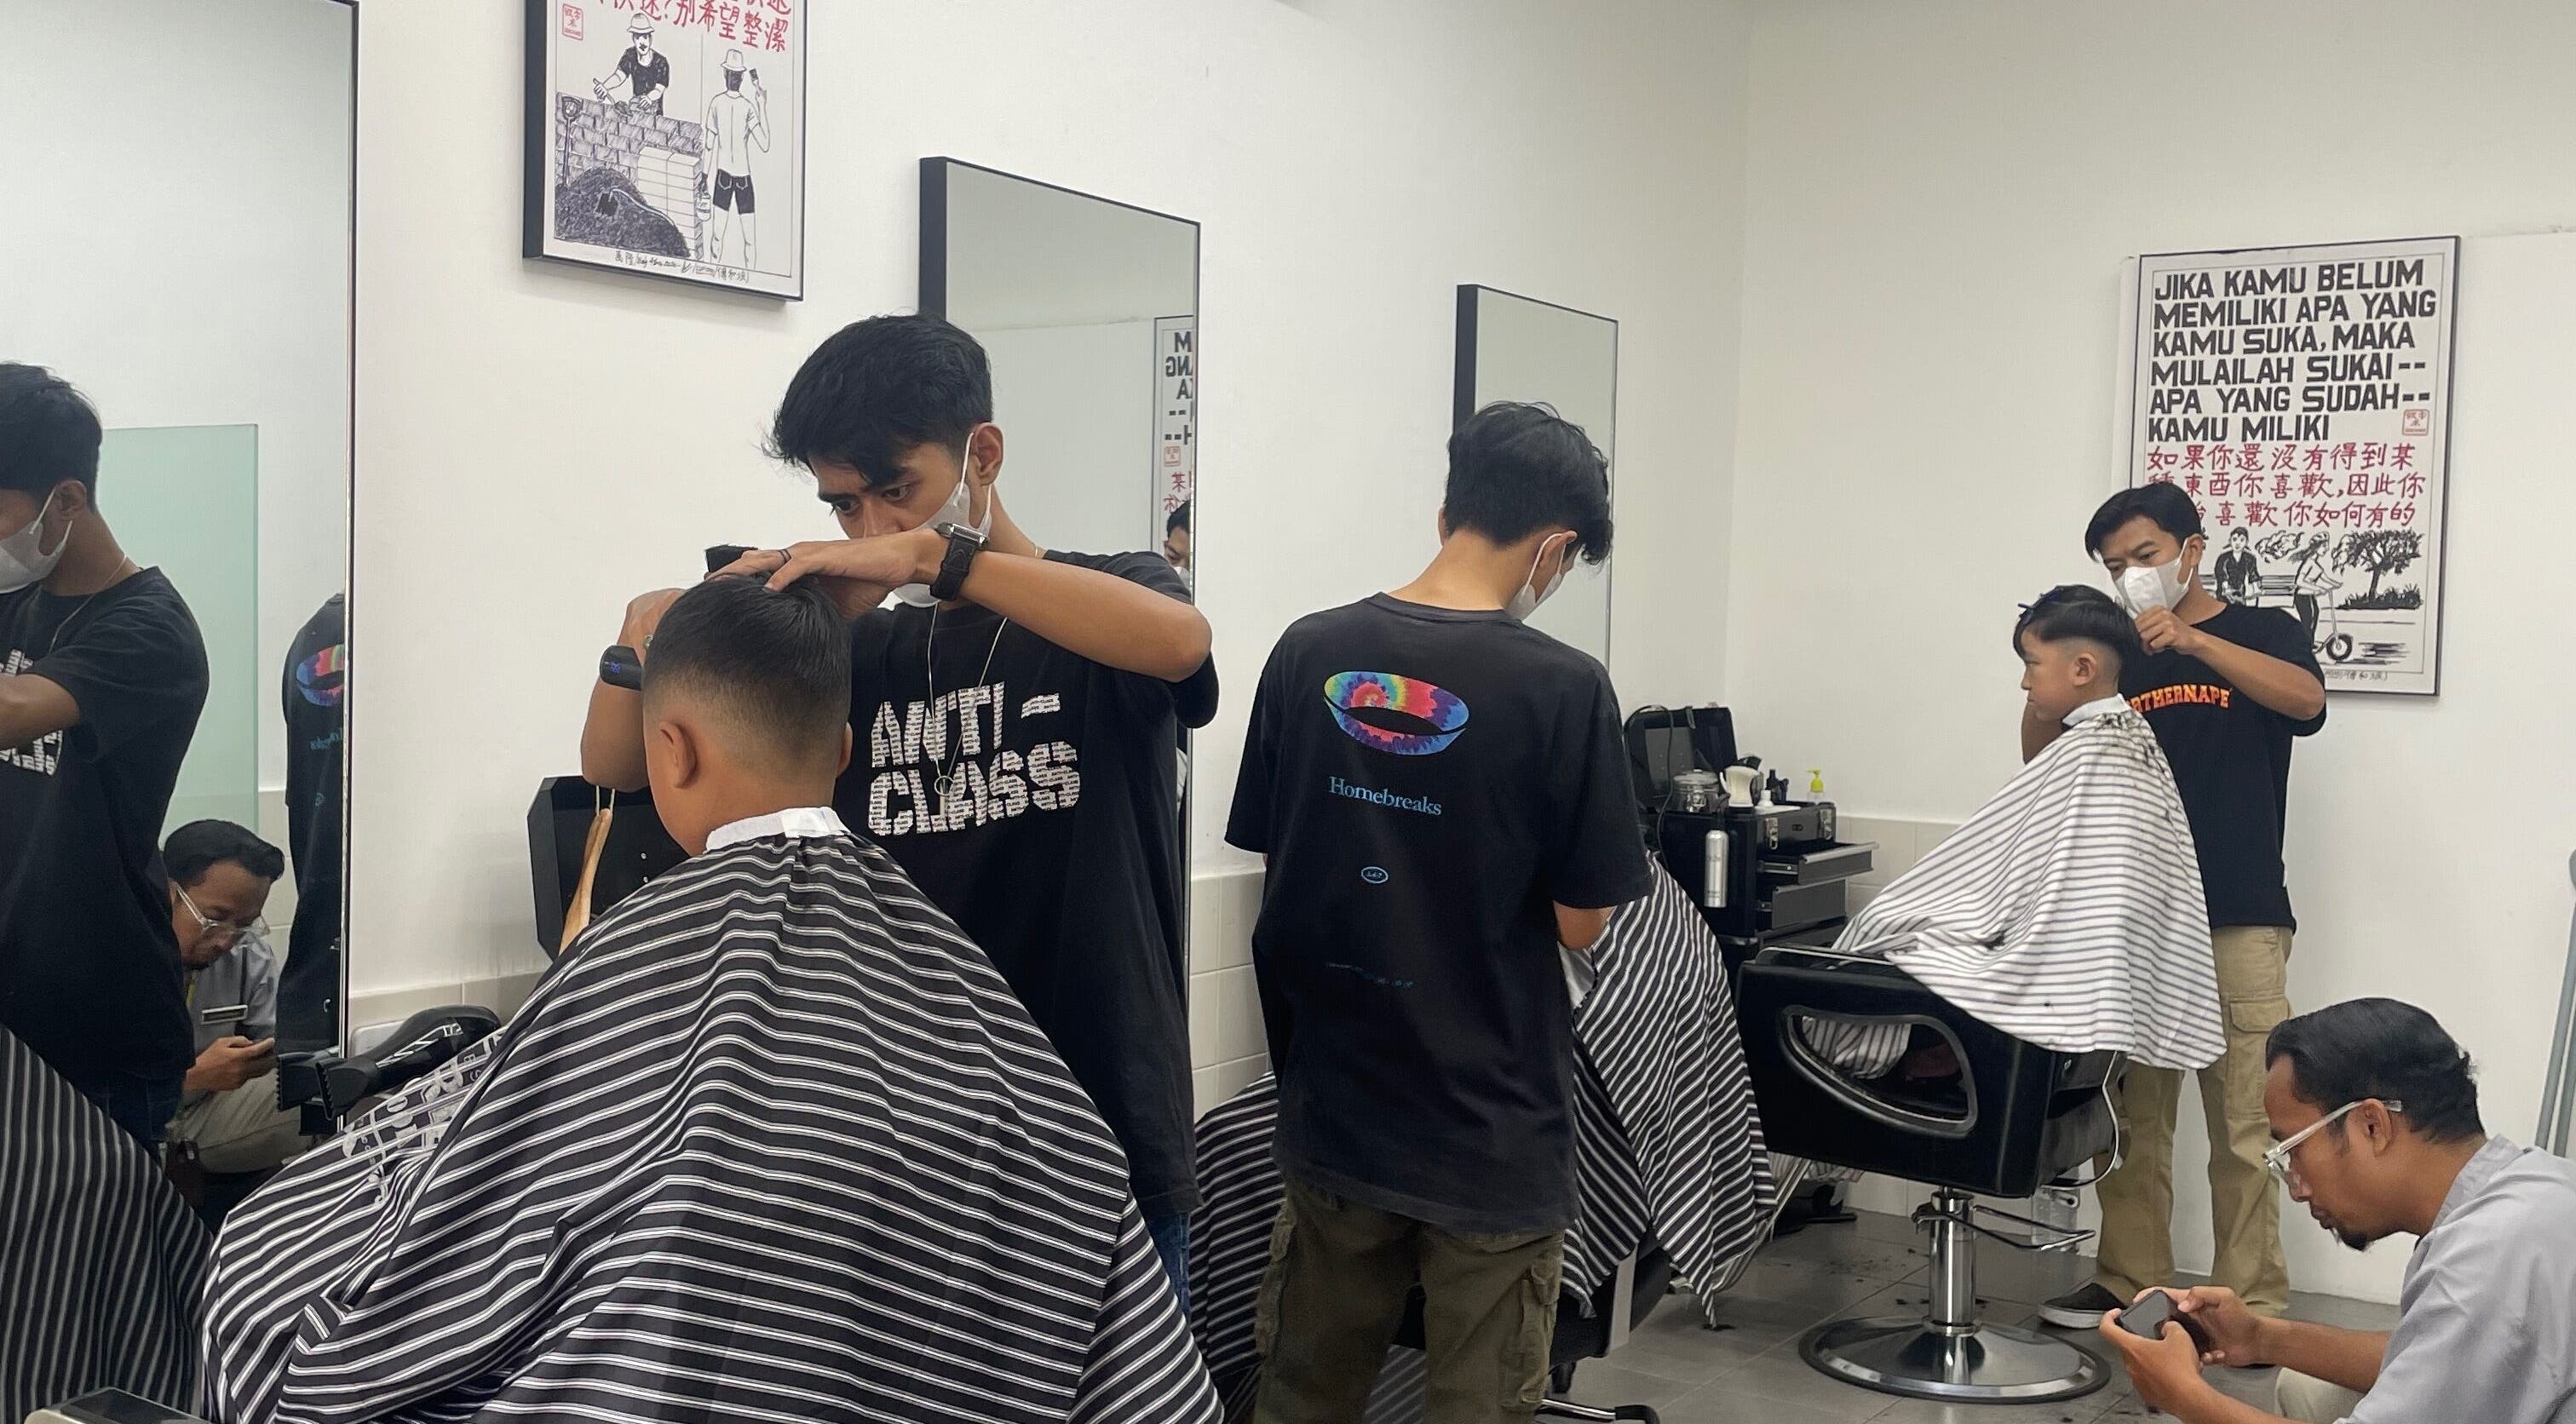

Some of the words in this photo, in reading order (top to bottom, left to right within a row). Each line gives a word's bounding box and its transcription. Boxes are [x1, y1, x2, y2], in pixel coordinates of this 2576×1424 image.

[2154, 271, 2214, 300] JIKA
[2224, 267, 2307, 296] KAMU
[2317, 259, 2424, 292] BELUM
[2153, 297, 2286, 330] MEMILIKI
[2296, 296, 2349, 323] APA
[2360, 290, 2436, 319] YANG
[2153, 330, 2234, 358] KAMU
[2243, 326, 2326, 355] SUKA,
[2332, 321, 2415, 351] MAKA
[2151, 356, 2295, 387] MULAILAH
[2149, 388, 2203, 415] APA
[2216, 386, 2291, 414] YANG
[2148, 414, 2228, 443] KAMU
[2241, 414, 2330, 442] MILIKI
[2126, 684, 2230, 713] RTHERNAPE
[868, 741, 1081, 835] CLASS
[1329, 776, 1442, 815] Homebreaks
